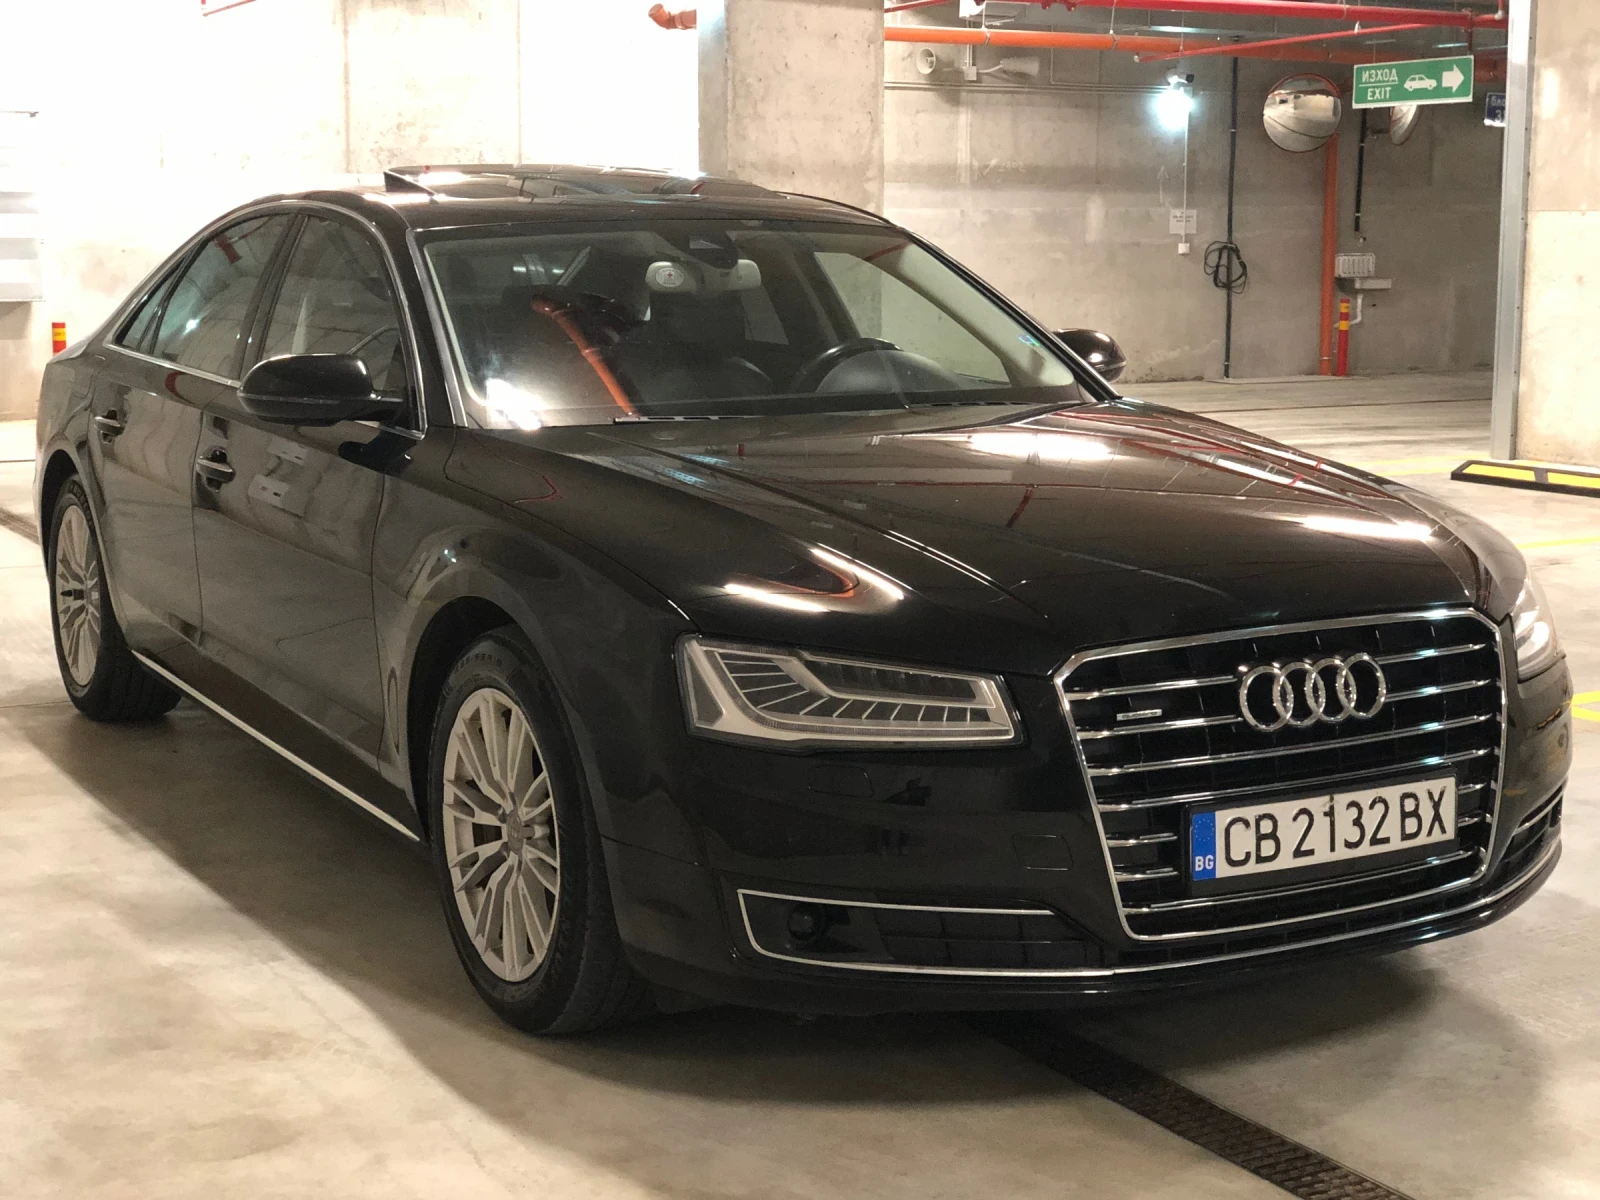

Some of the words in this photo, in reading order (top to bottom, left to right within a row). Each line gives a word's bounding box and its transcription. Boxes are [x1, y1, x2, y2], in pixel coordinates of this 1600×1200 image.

[1362, 68, 1399, 84] ИЗХОД
[1367, 87, 1391, 100] EXIT
[1224, 813, 1281, 867] CB
[1292, 796, 1391, 860] 2132
[1400, 786, 1447, 841] BX
[1195, 855, 1214, 871] BG
